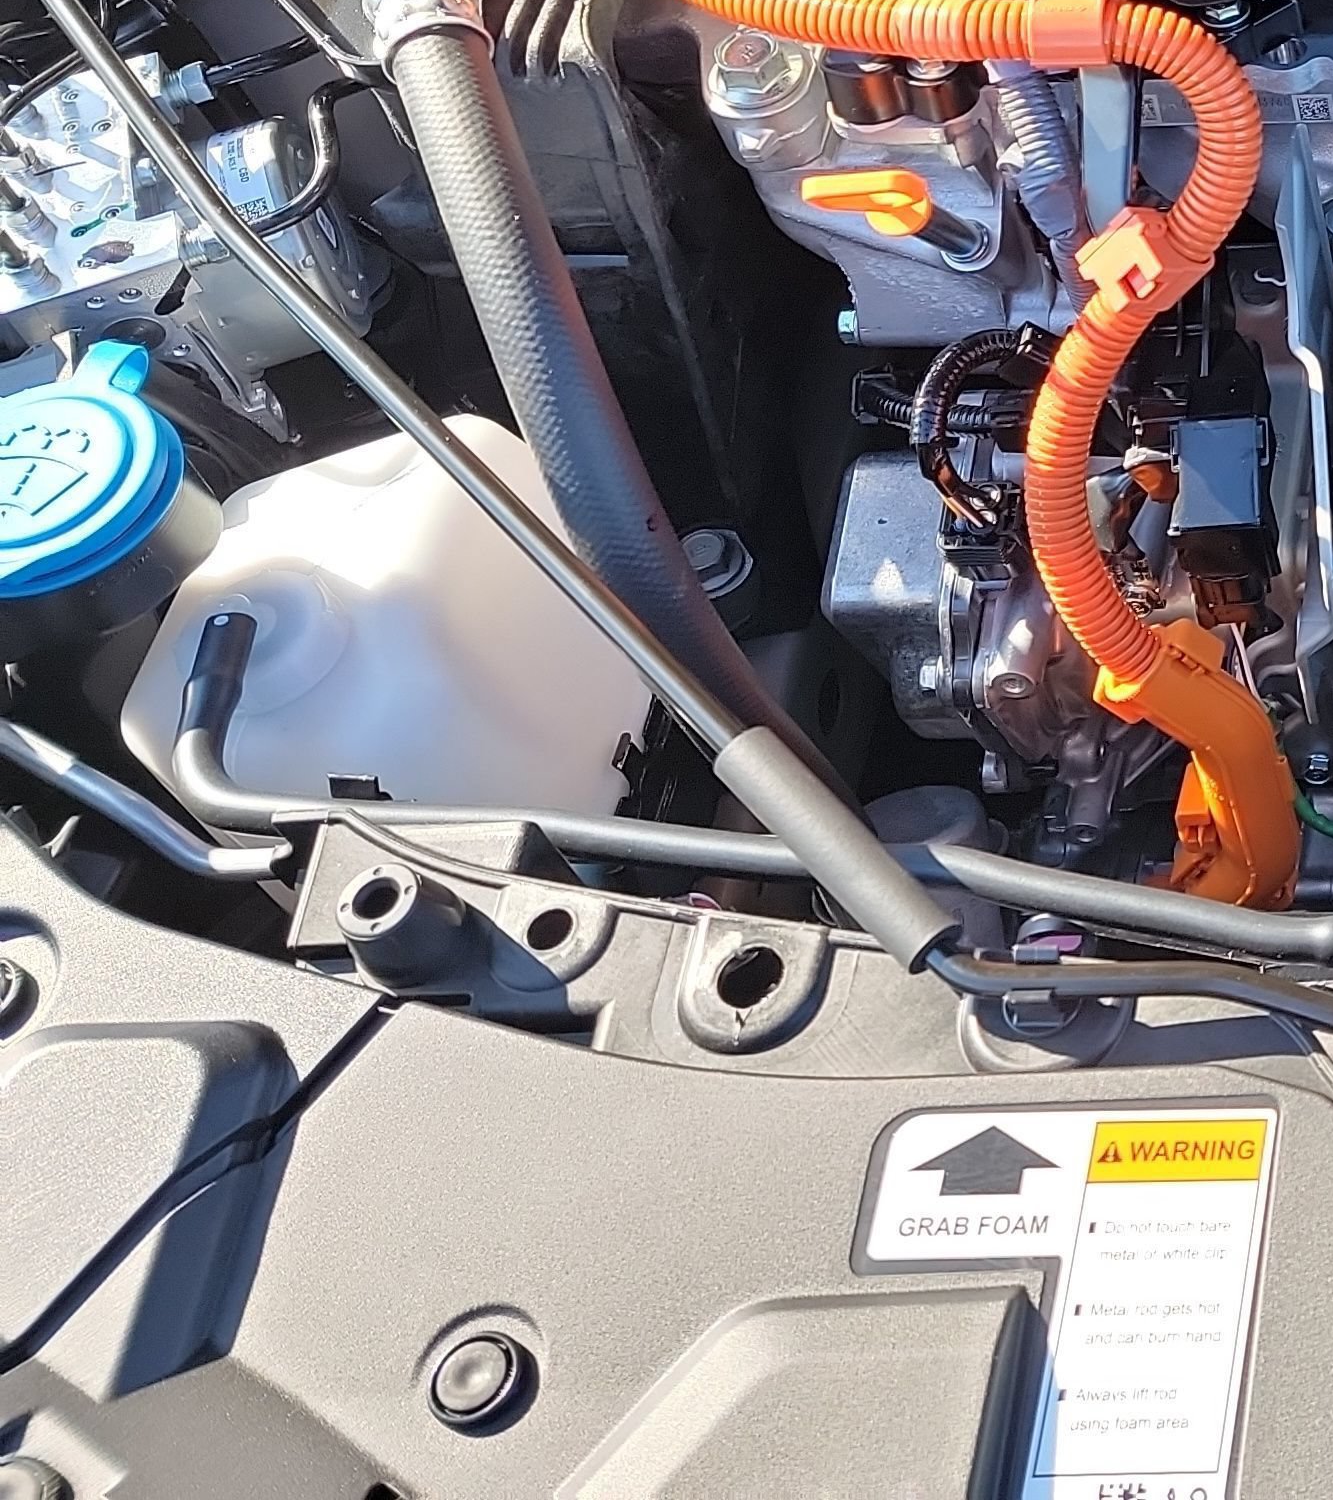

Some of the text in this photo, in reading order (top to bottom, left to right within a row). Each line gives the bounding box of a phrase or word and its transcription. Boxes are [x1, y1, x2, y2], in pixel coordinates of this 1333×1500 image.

[1129, 1139, 1256, 1162] WARNING
[897, 1214, 1050, 1237] GRAB FOAM
[1162, 1246, 1199, 1260] white
[1162, 1301, 1193, 1320] gets
[1154, 1387, 1177, 1401] rod
[1070, 1415, 1189, 1435] using foam area
